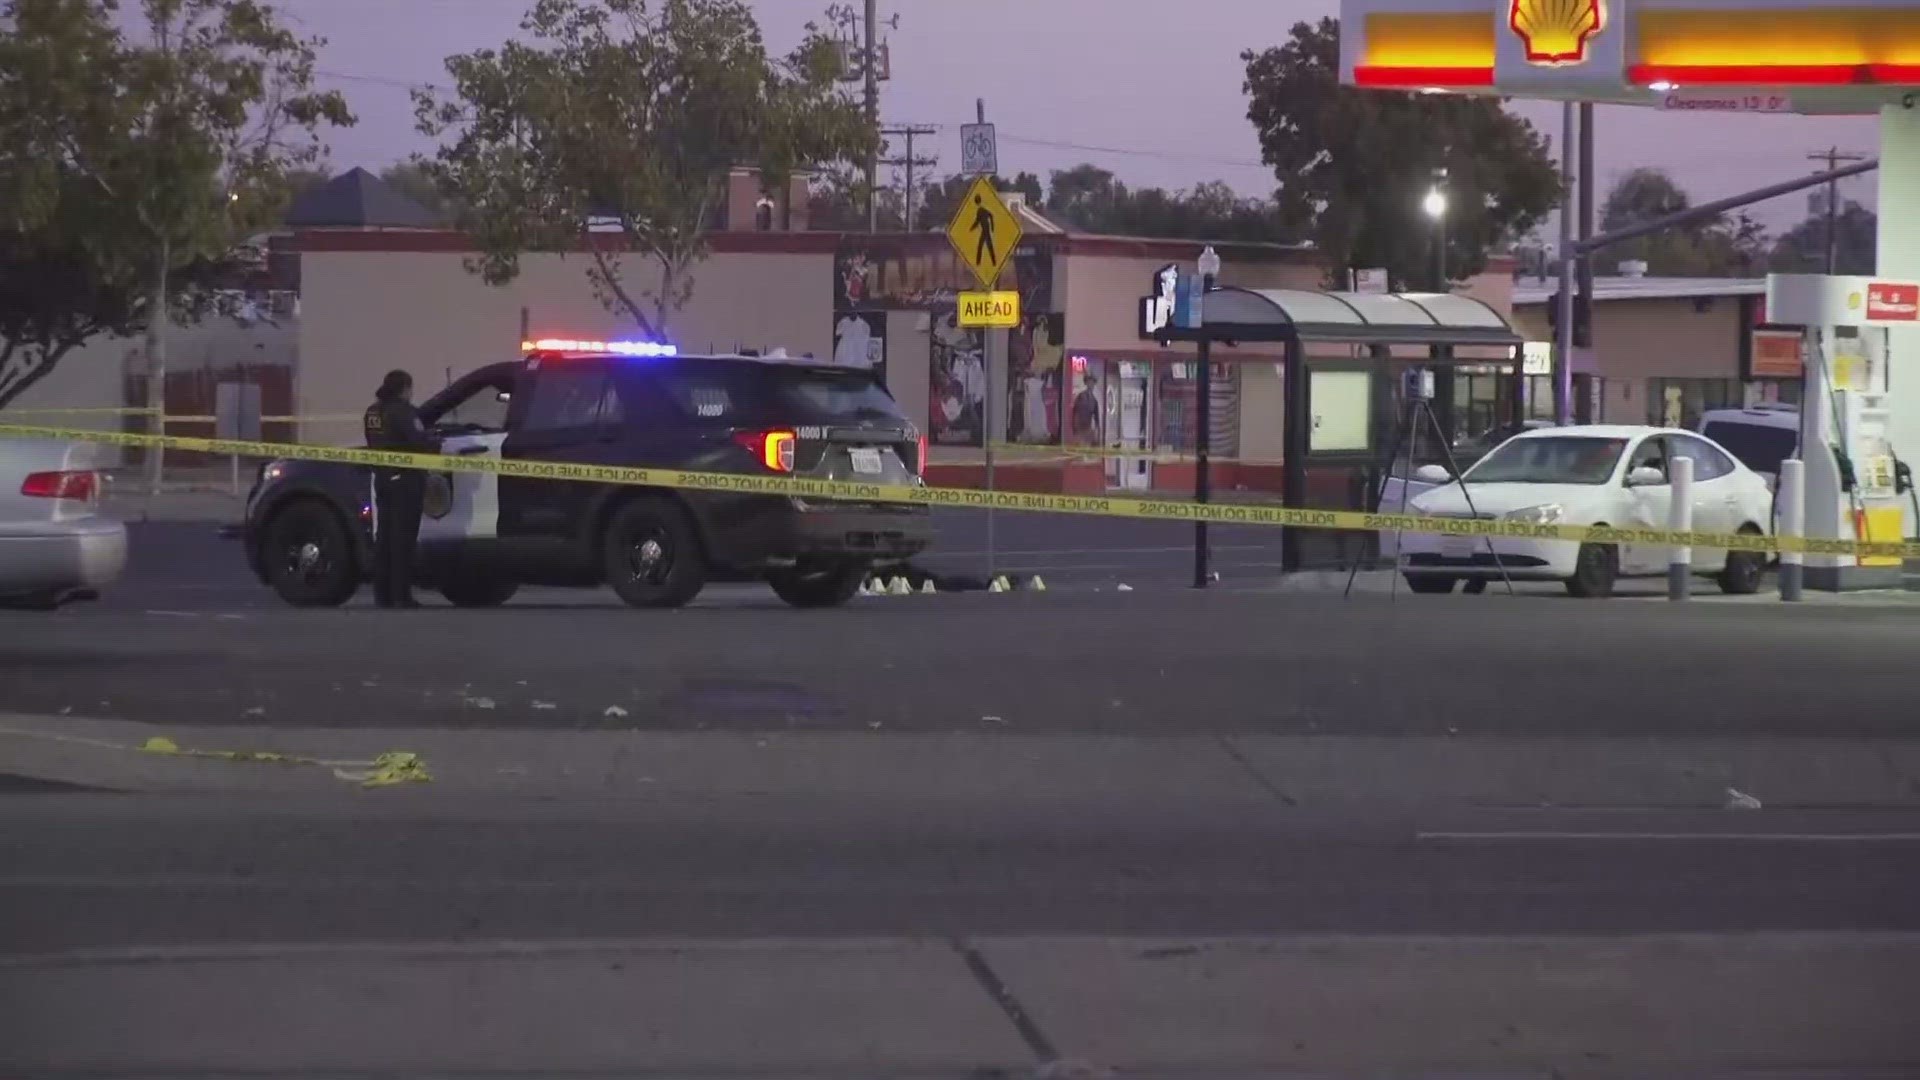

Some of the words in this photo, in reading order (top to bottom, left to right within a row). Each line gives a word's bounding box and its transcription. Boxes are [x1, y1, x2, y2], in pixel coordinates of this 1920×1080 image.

[1665, 94, 1736, 110] Clearance
[964, 301, 1013, 318] AHEAD
[697, 403, 724, 417] 14000
[796, 425, 820, 440] 14000
